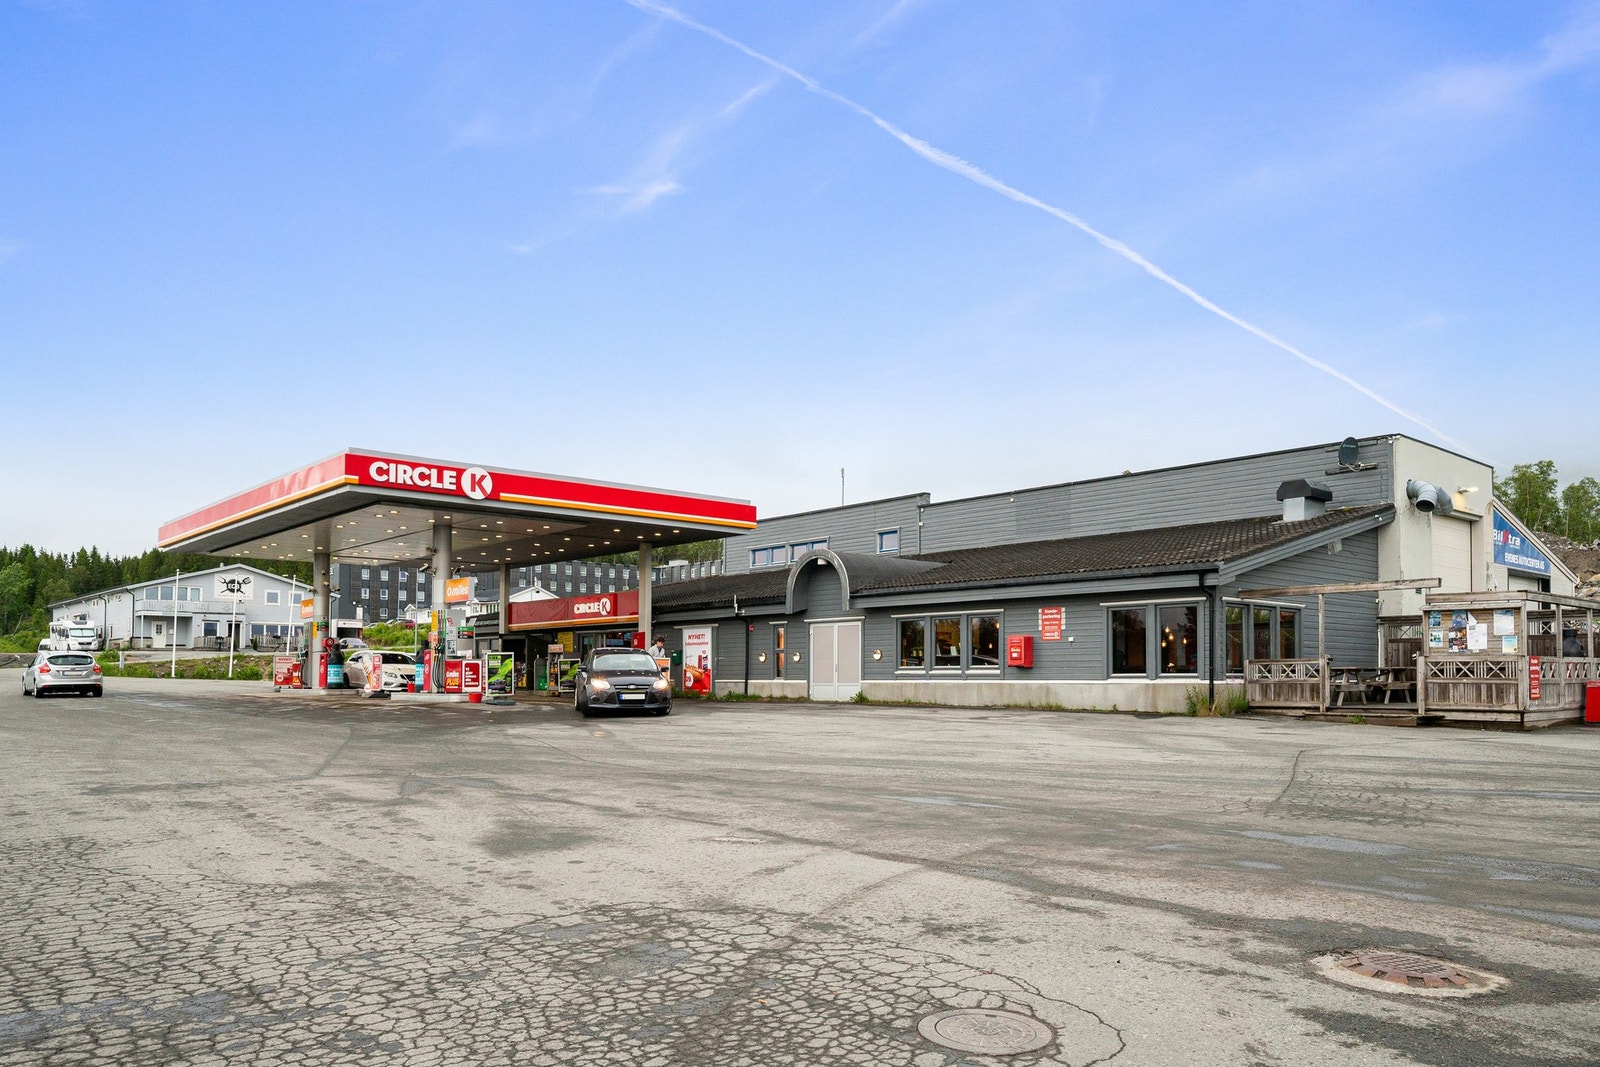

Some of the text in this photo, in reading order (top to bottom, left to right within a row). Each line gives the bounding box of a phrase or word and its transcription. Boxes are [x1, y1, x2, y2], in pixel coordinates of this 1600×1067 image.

[369, 461, 491, 499] CIRCLE K
[574, 602, 600, 614] CIRCLE
[446, 677, 459, 686] PLUS
